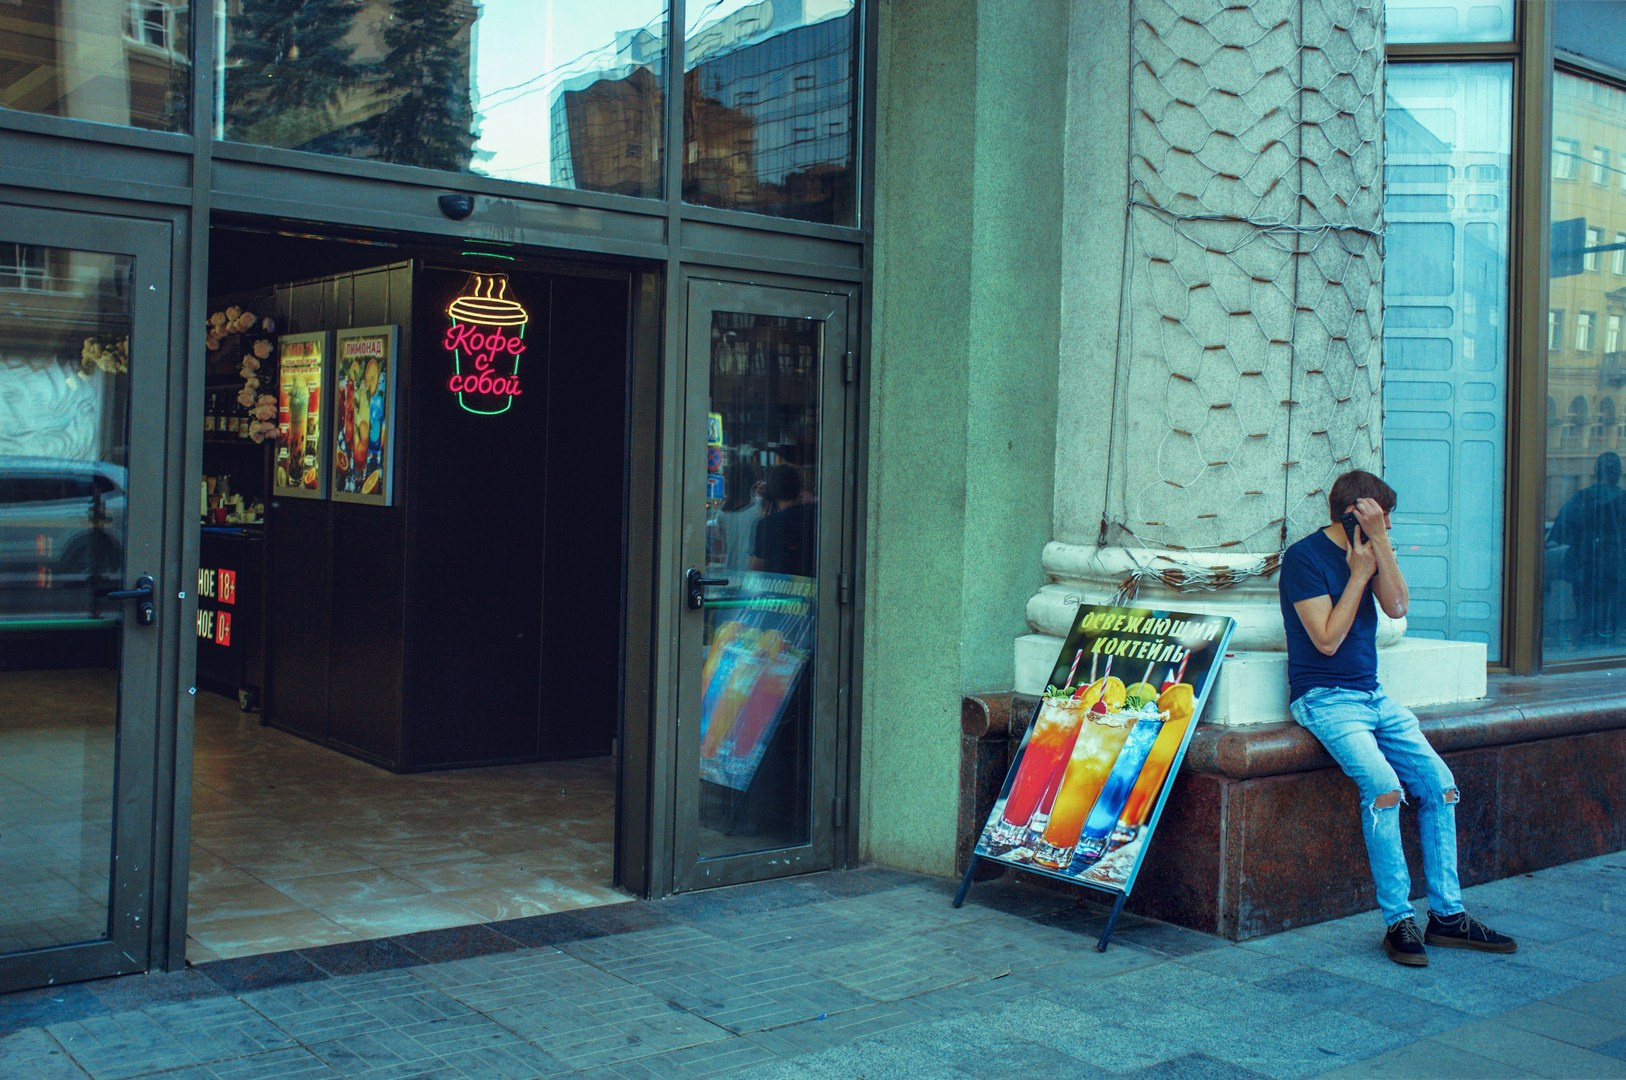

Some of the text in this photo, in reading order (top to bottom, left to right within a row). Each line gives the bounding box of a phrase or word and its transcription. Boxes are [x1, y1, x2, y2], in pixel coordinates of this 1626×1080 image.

[346, 341, 382, 357] ЛИМОНАД
[444, 323, 526, 362] Кофе
[475, 353, 490, 371] с
[449, 368, 522, 396] собой
[219, 571, 235, 601] 18+
[218, 613, 230, 642] 0+
[1081, 611, 1222, 642] ОСВЕЖАЮЩИЙ
[1090, 636, 1185, 664] КОКТЕЙЛЬ
